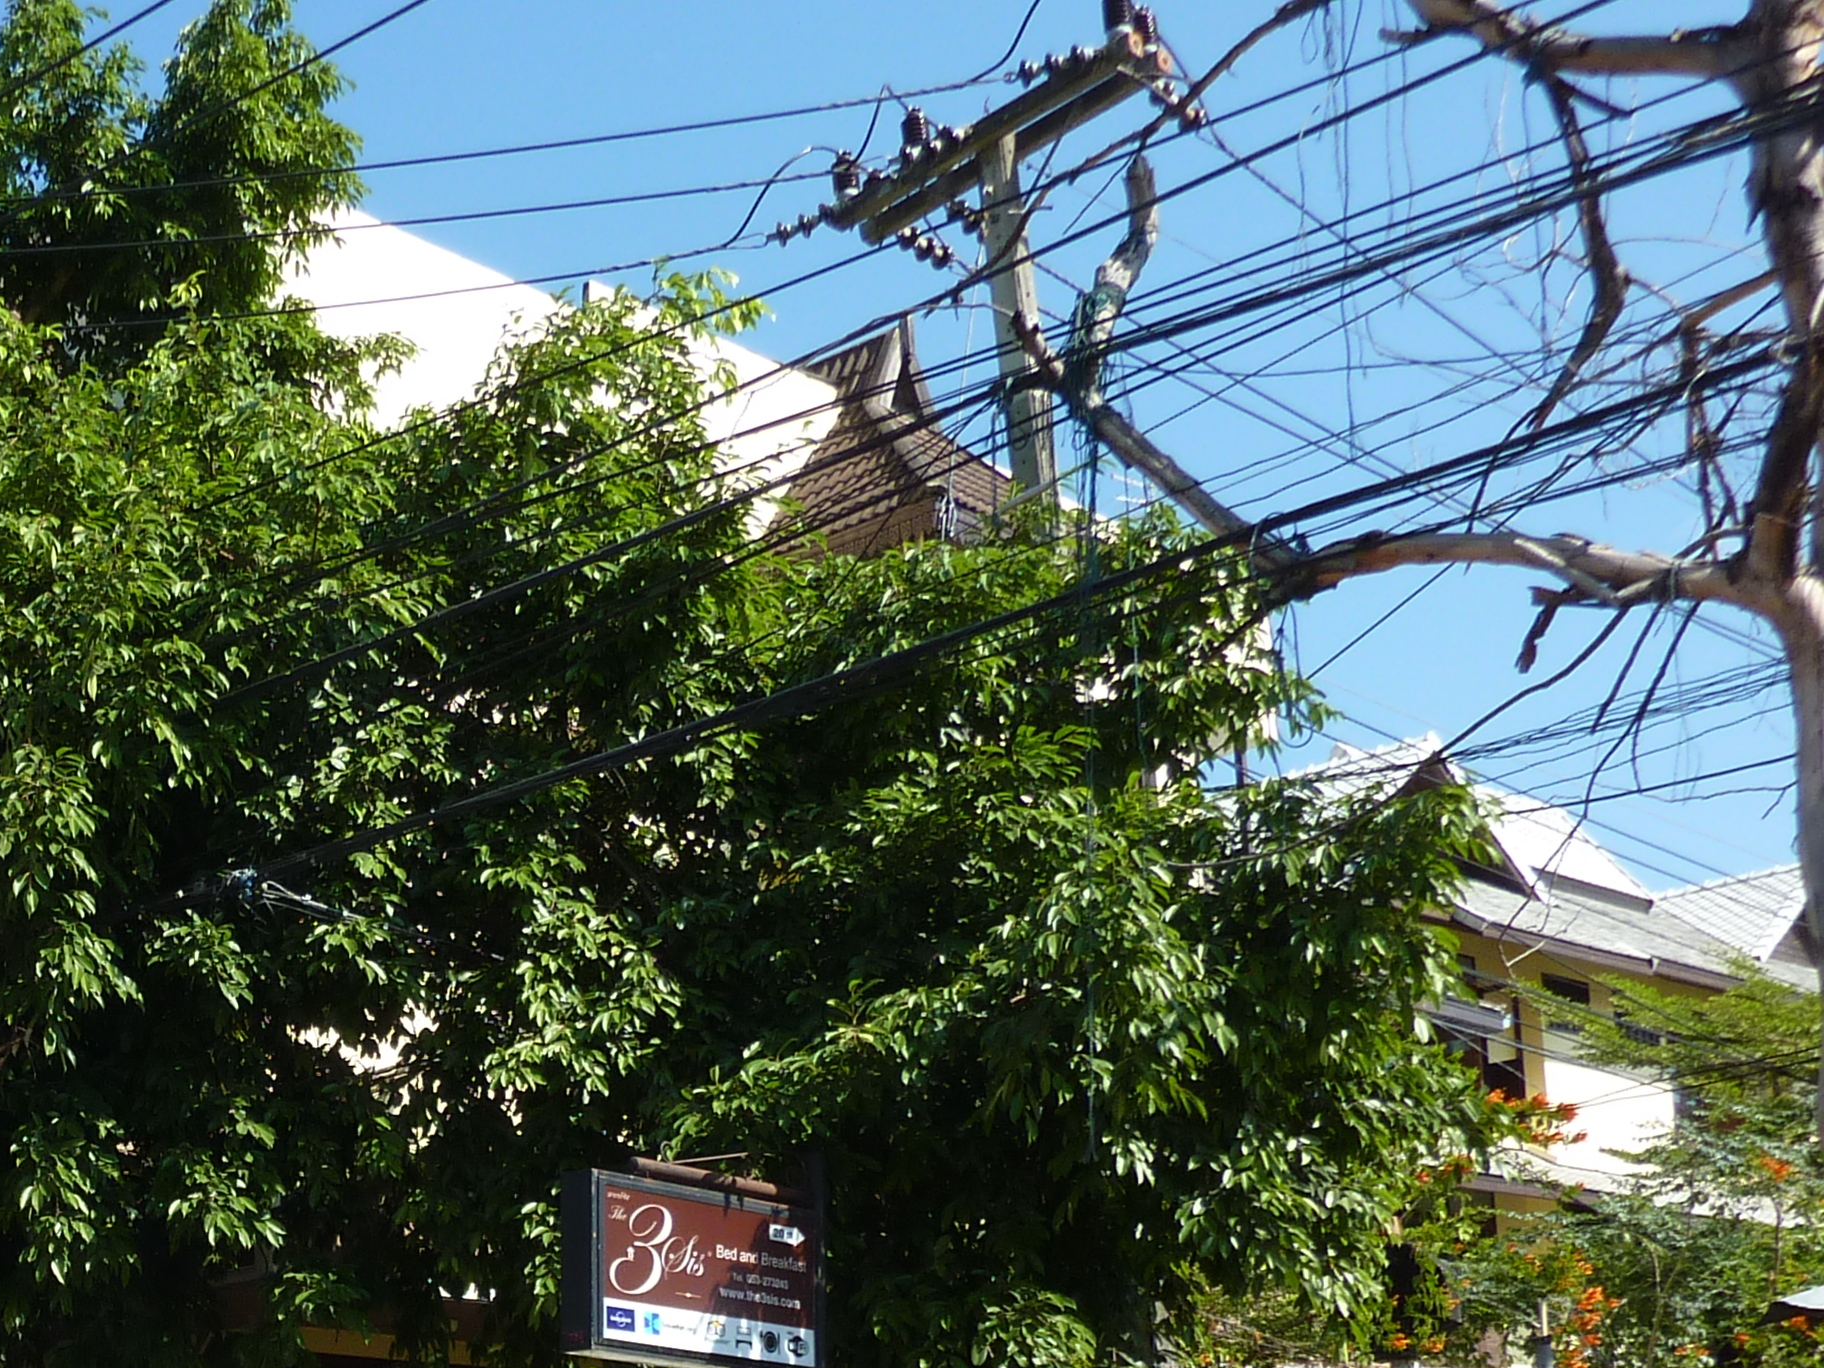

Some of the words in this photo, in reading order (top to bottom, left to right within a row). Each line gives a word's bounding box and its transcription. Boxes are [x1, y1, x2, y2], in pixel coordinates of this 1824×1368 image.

[609, 1203, 673, 1295] 3
[715, 1243, 738, 1261] Bed
[739, 1250, 759, 1265] and
[760, 1252, 808, 1273] Breakfast
[718, 1287, 801, 1310] www.the3sis.com
